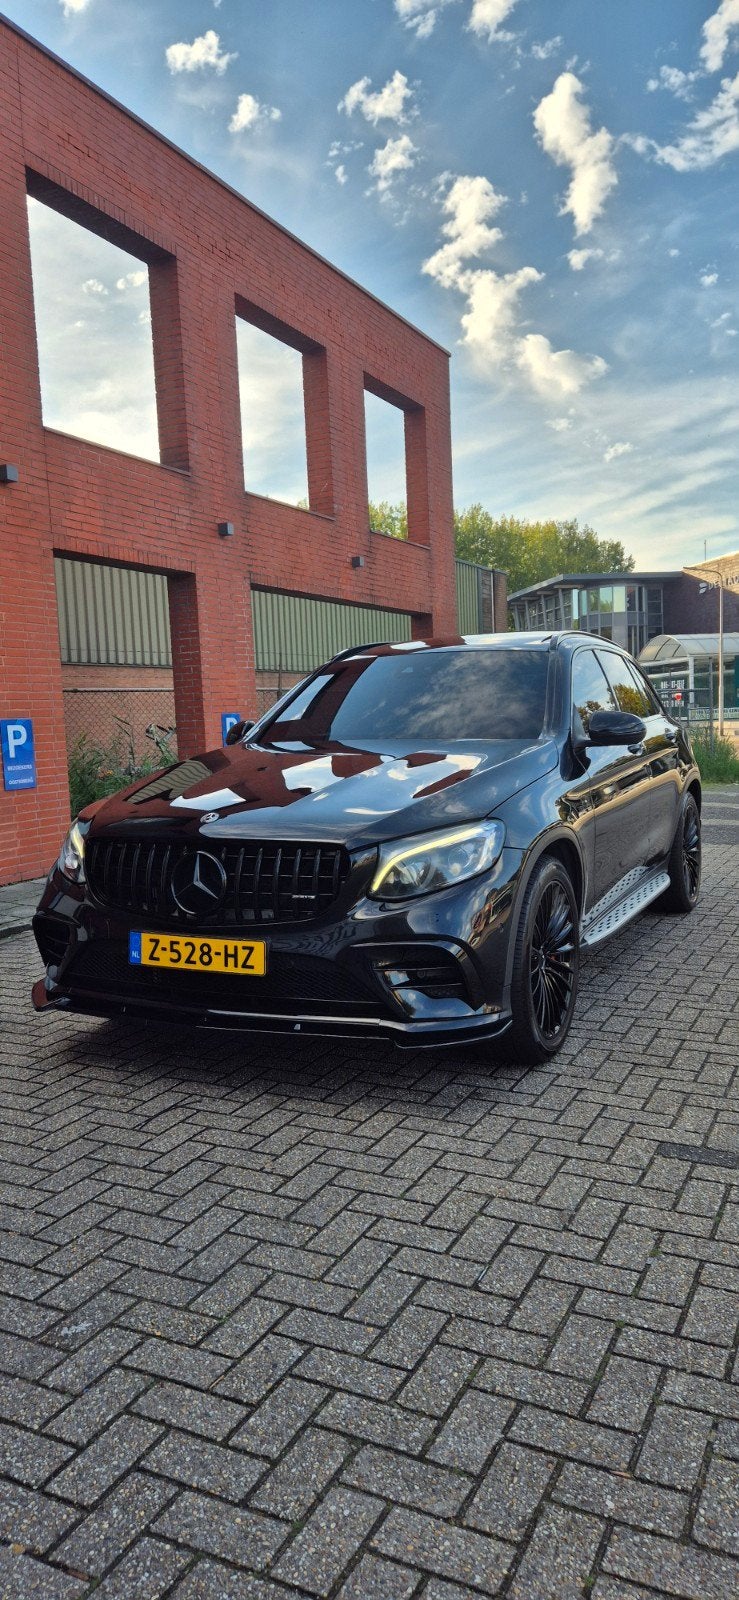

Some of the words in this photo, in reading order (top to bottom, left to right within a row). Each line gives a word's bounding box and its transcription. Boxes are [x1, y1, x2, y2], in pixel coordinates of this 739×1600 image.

[7, 724, 27, 758] P
[131, 950, 140, 958] NL
[148, 938, 255, 970] Z-528-HZ
